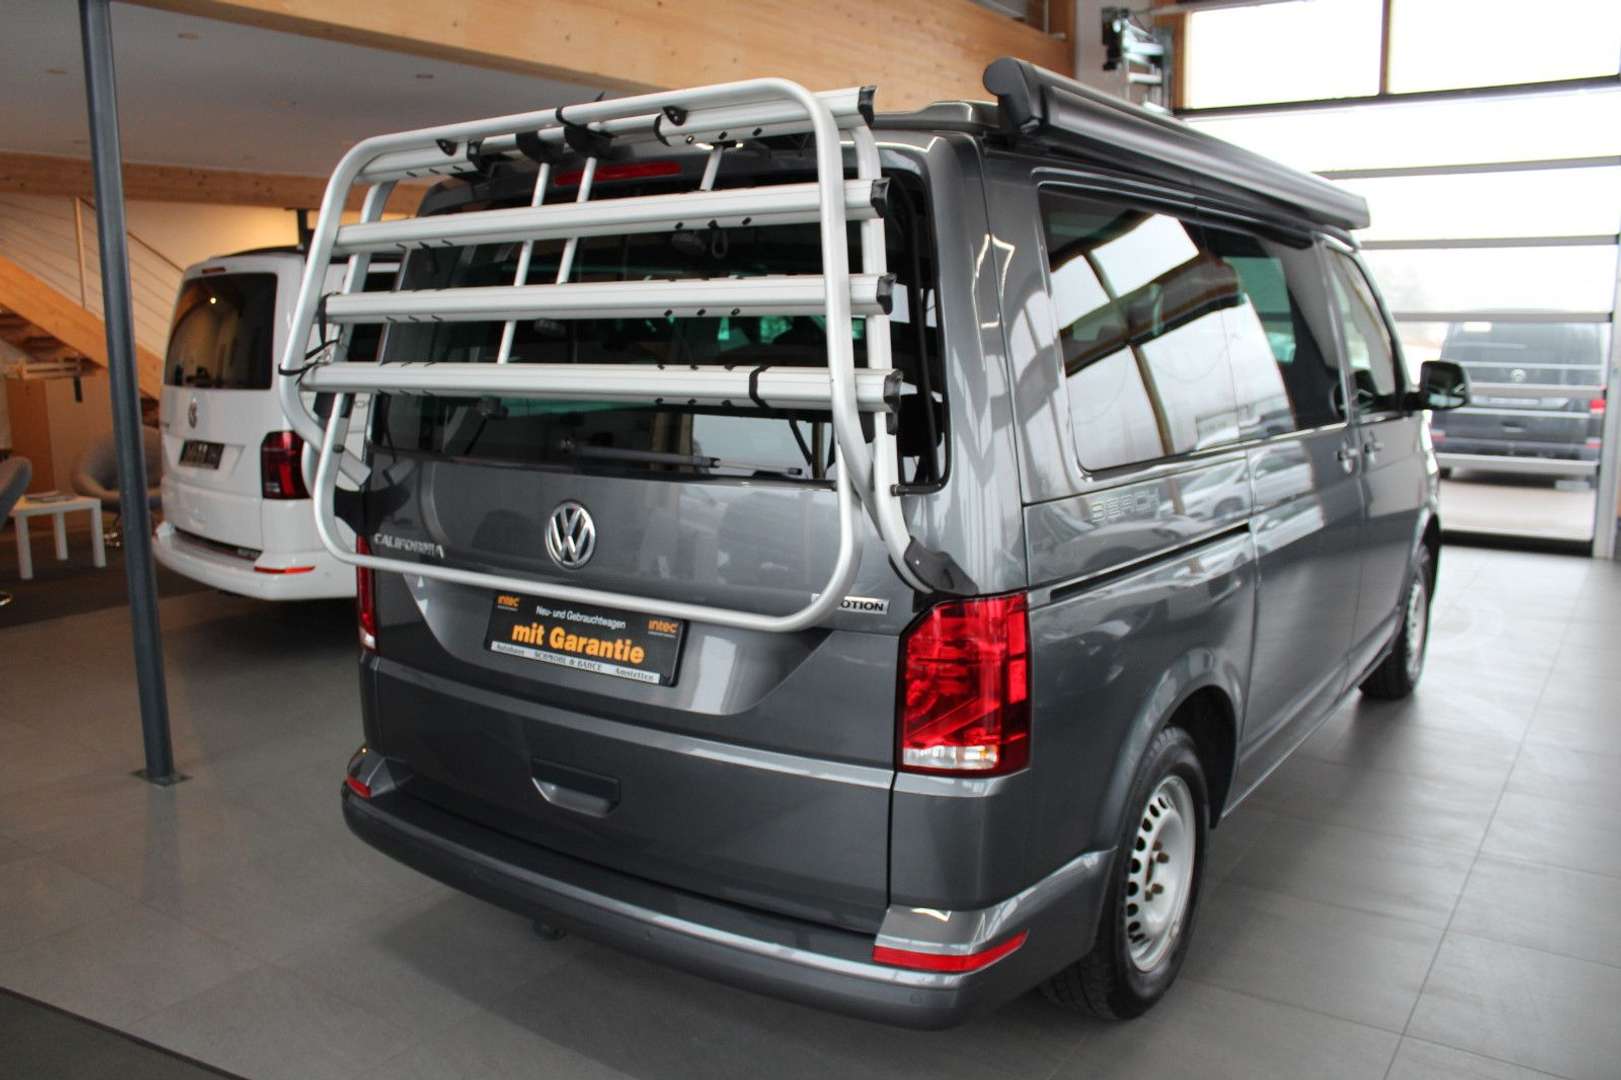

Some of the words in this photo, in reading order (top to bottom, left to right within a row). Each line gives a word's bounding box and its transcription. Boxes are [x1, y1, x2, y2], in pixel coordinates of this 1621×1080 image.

[841, 599, 885, 612] OTION
[553, 608, 566, 619] und
[566, 610, 626, 630] Gebrauchtwagen
[512, 622, 545, 646] mit
[549, 626, 646, 665] Garantie
